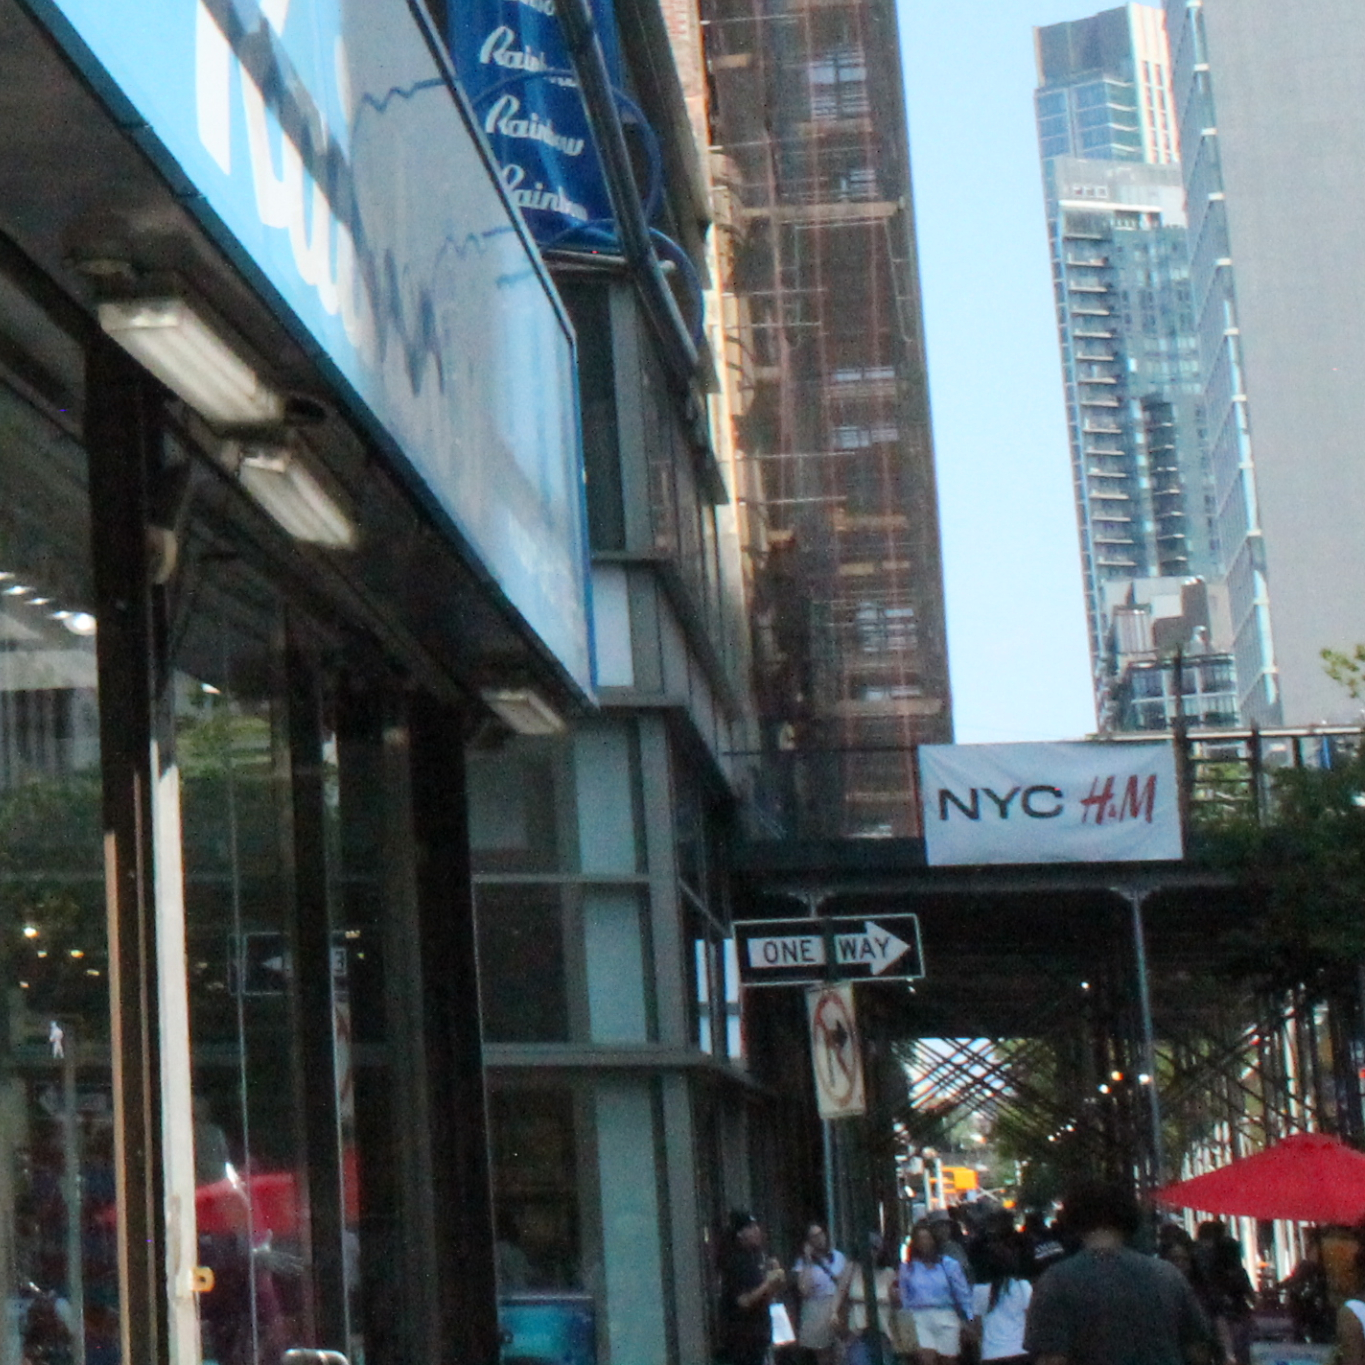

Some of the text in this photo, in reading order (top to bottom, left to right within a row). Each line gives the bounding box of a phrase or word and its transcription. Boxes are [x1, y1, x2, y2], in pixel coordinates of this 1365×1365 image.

[938, 773, 1158, 825] NYC H&M
[762, 935, 891, 964] ONE WAY
